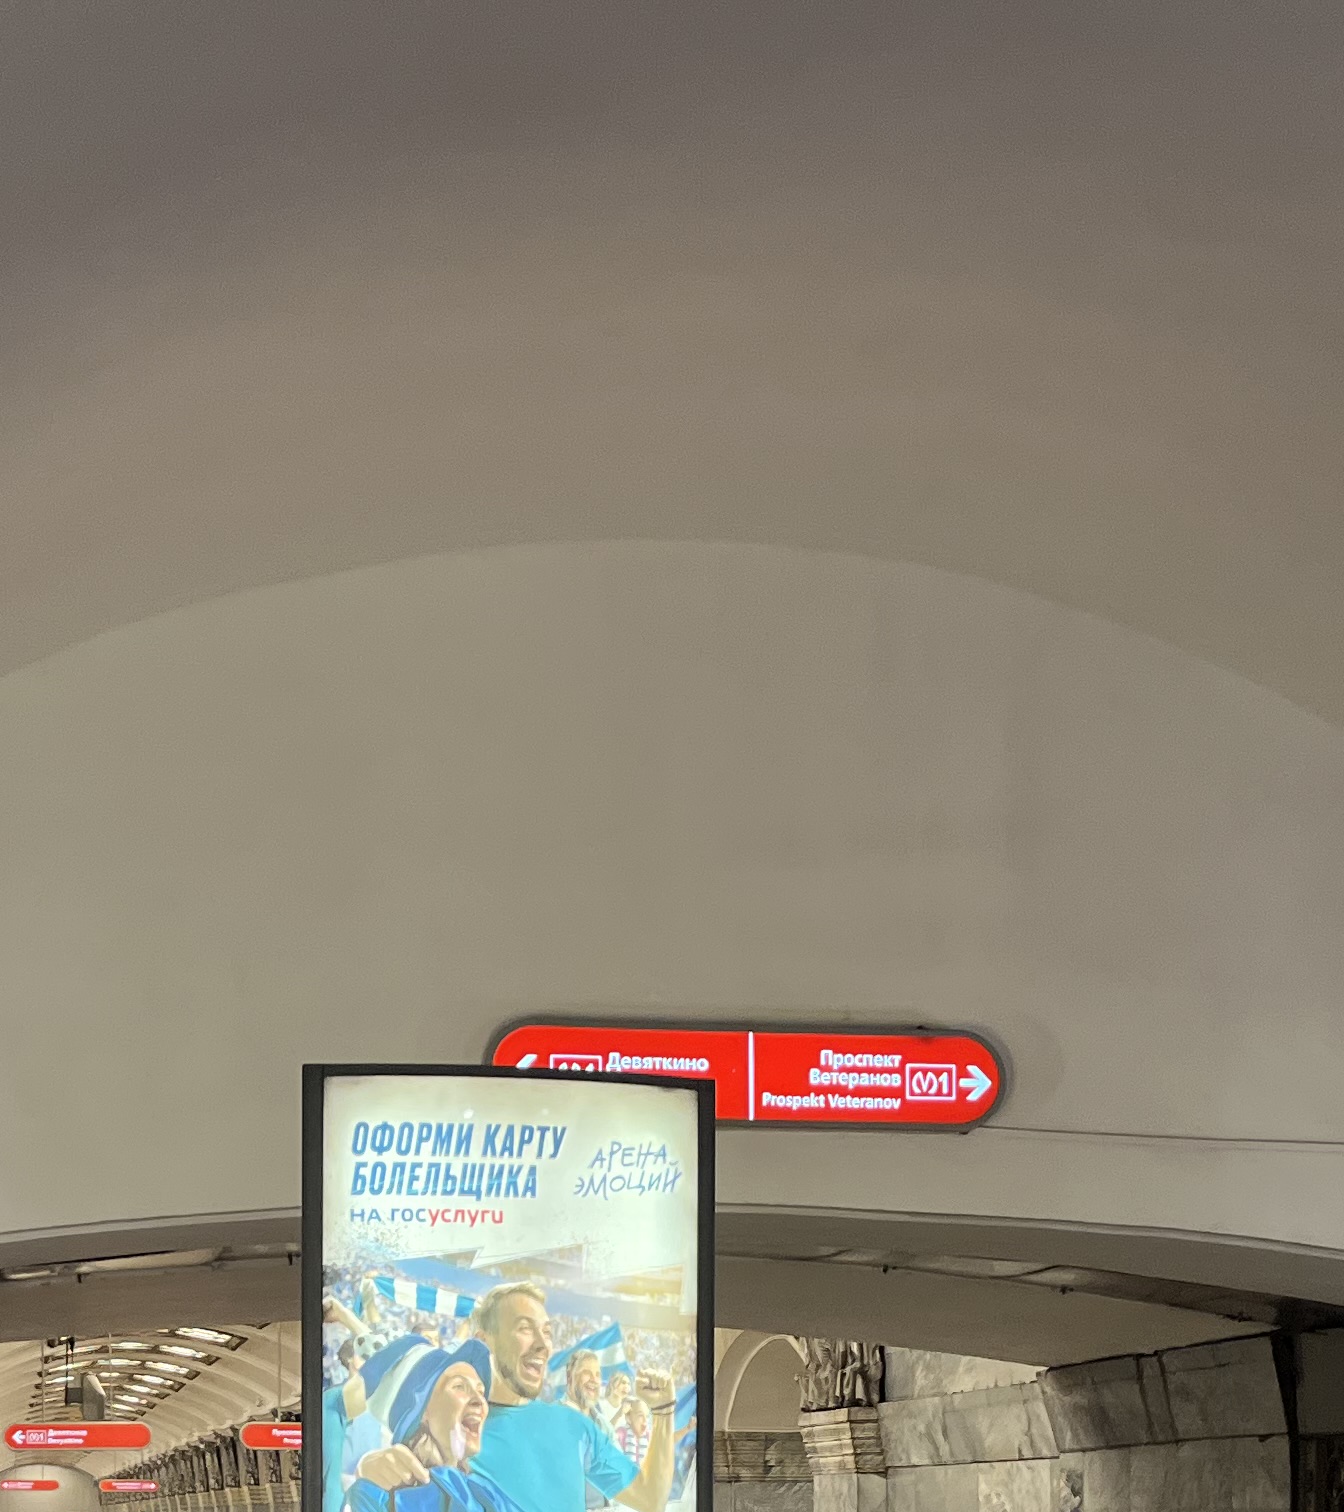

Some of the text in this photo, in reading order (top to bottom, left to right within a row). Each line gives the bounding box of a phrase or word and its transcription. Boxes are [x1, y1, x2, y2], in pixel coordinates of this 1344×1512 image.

[607, 1052, 709, 1073] Девяткино
[820, 1049, 903, 1069] Проспект
[809, 1067, 902, 1089] Ветеранов
[761, 1091, 902, 1111] Prospekt Veteranov
[351, 1121, 567, 1160] ОФОРМИ КАРТУ
[588, 1141, 668, 1171] АРЕНА
[350, 1161, 538, 1201] БОЛЕЛЬЩИКА
[573, 1160, 682, 1200] ЭМОЦИЙ
